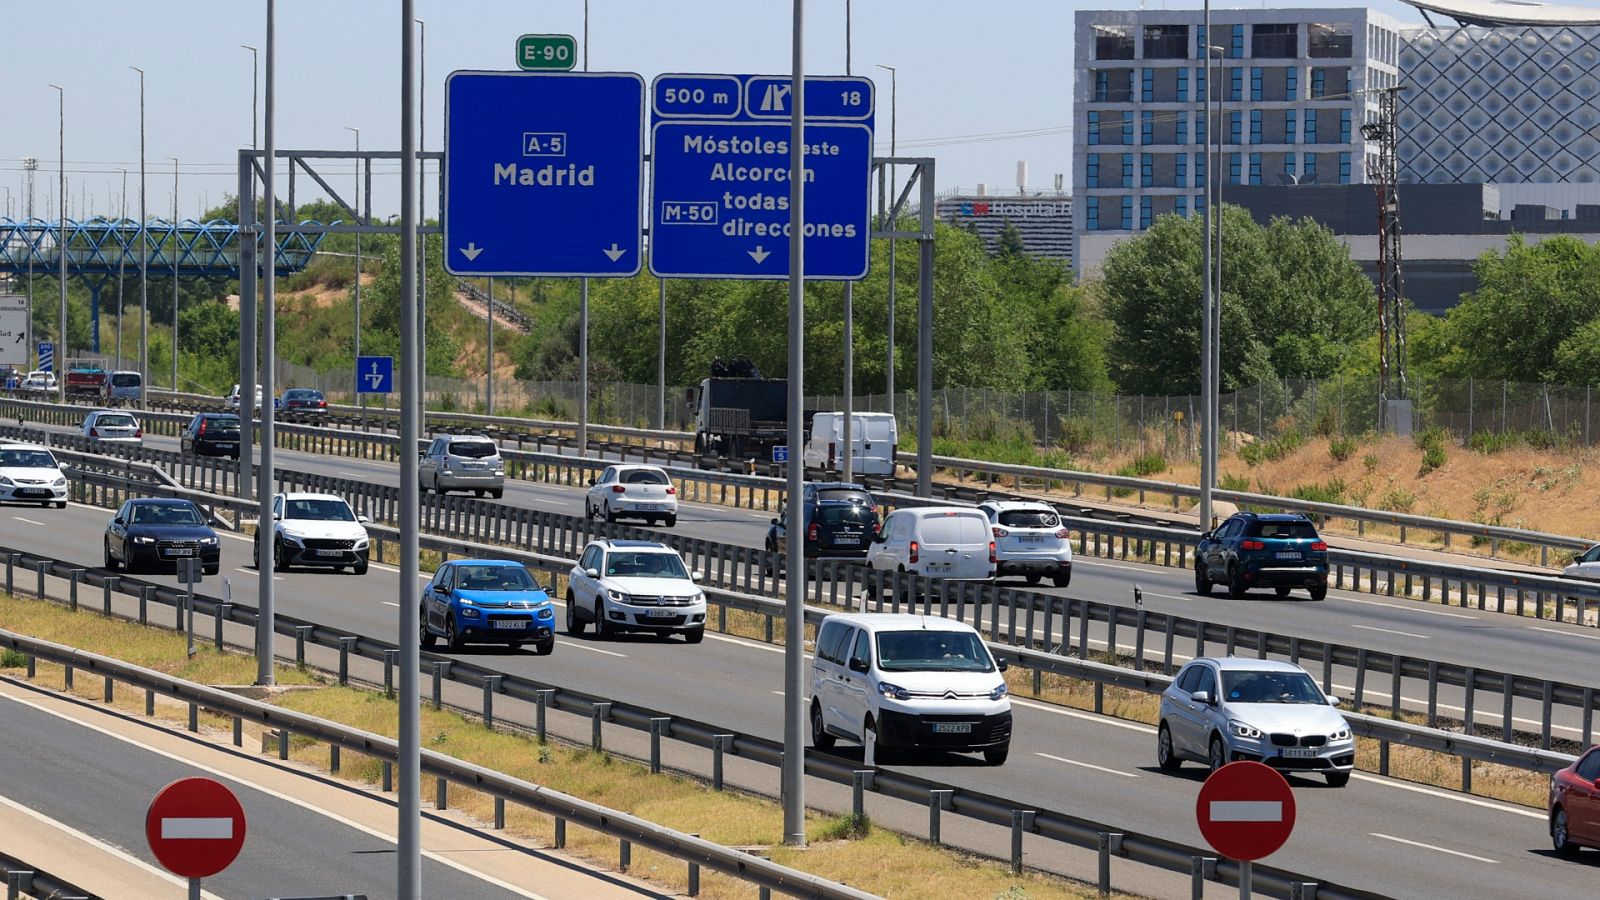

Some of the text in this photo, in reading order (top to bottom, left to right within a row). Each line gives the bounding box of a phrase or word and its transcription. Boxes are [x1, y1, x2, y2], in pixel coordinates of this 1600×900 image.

[525, 45, 569, 61] E-90
[664, 88, 728, 104] 500 m
[841, 91, 861, 105] 18
[528, 137, 562, 152] A-5
[683, 135, 840, 155] Móstoles este
[494, 163, 595, 187] Madrid
[710, 163, 815, 183] Alcorcn
[723, 191, 789, 211] todas
[992, 201, 1057, 219] Hospital
[665, 205, 714, 221] M-50
[723, 217, 857, 238] direccones
